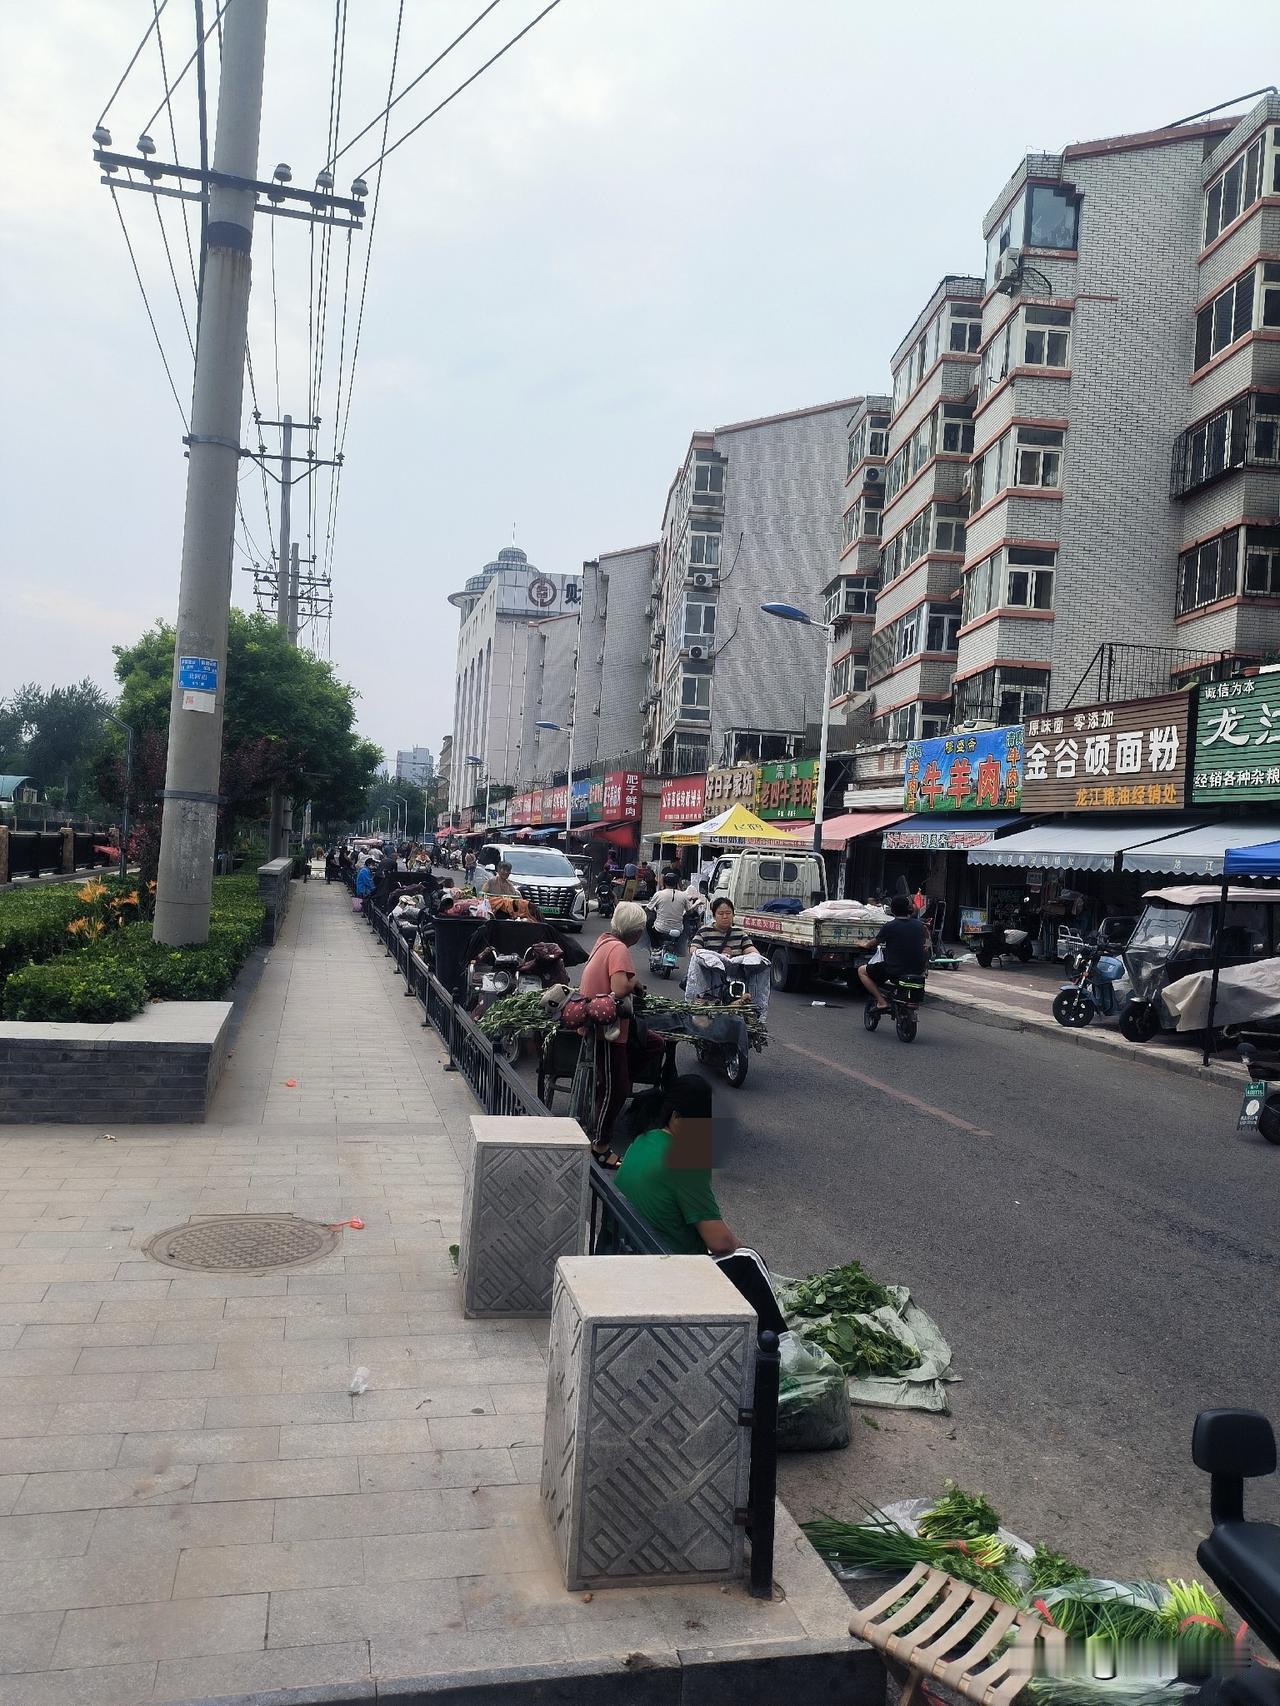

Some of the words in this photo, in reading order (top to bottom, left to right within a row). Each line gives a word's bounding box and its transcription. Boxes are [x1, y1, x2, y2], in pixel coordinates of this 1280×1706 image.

[1204, 679, 1256, 700] 诚信为本
[1028, 717, 1064, 737] 原味面
[1073, 709, 1114, 732] 零添加
[1024, 725, 1180, 781] 金谷硕面粉
[705, 771, 753, 800] 好日子家纺
[920, 754, 1002, 810] 牛羊肉
[1004, 746, 1021, 808] 牛肉片
[625, 774, 639, 817] 肥子鲜肉
[761, 778, 813, 809] 老四牛羊肉
[1075, 783, 1178, 807] 龙江粮油经销处
